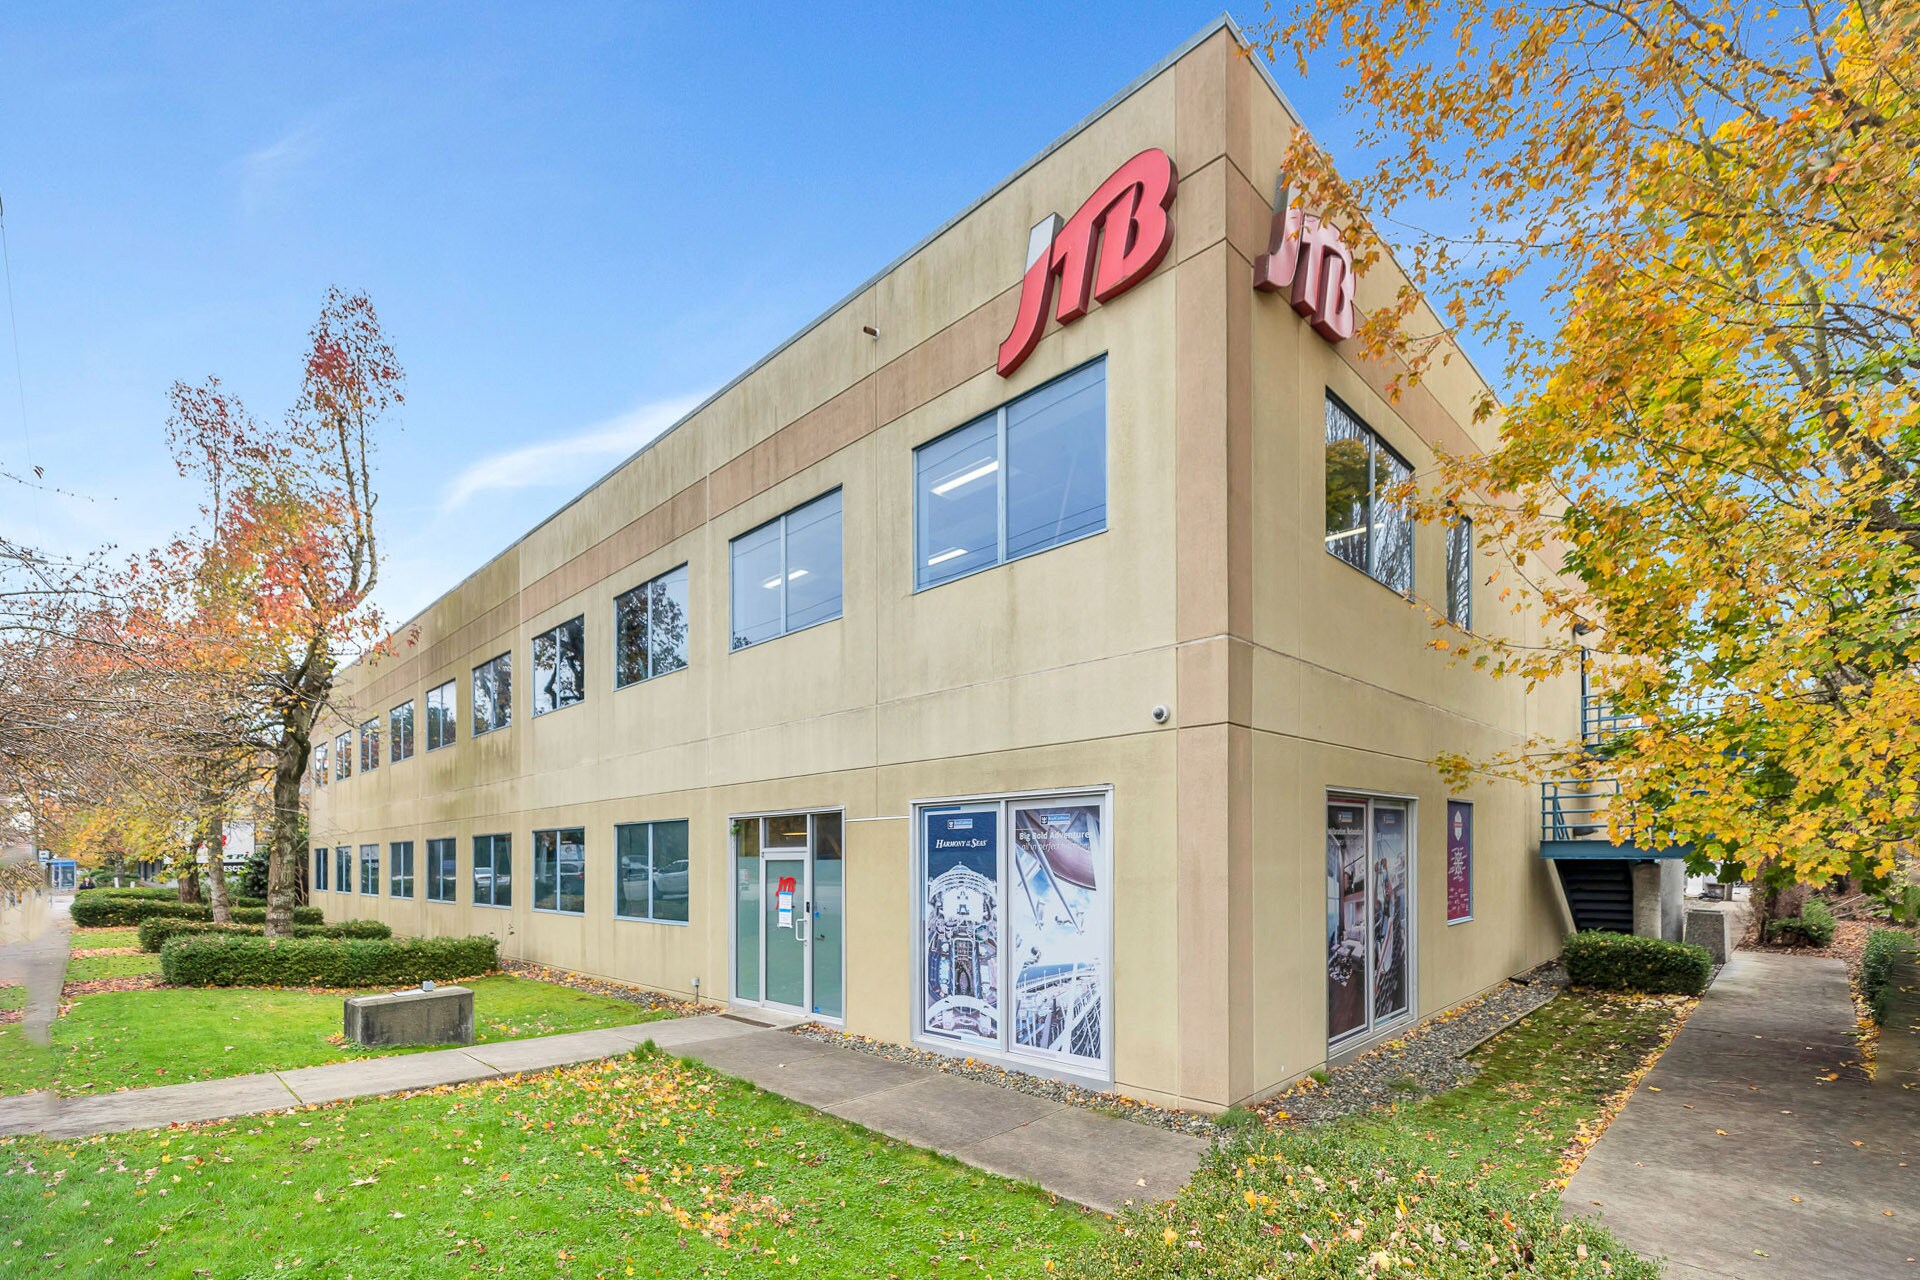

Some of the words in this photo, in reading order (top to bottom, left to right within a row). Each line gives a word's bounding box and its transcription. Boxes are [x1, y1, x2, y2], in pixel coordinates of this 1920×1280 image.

[997, 148, 1178, 379] JTB
[1254, 172, 1356, 344] JTB
[1019, 832, 1031, 842] Big
[1032, 831, 1048, 840] Bold
